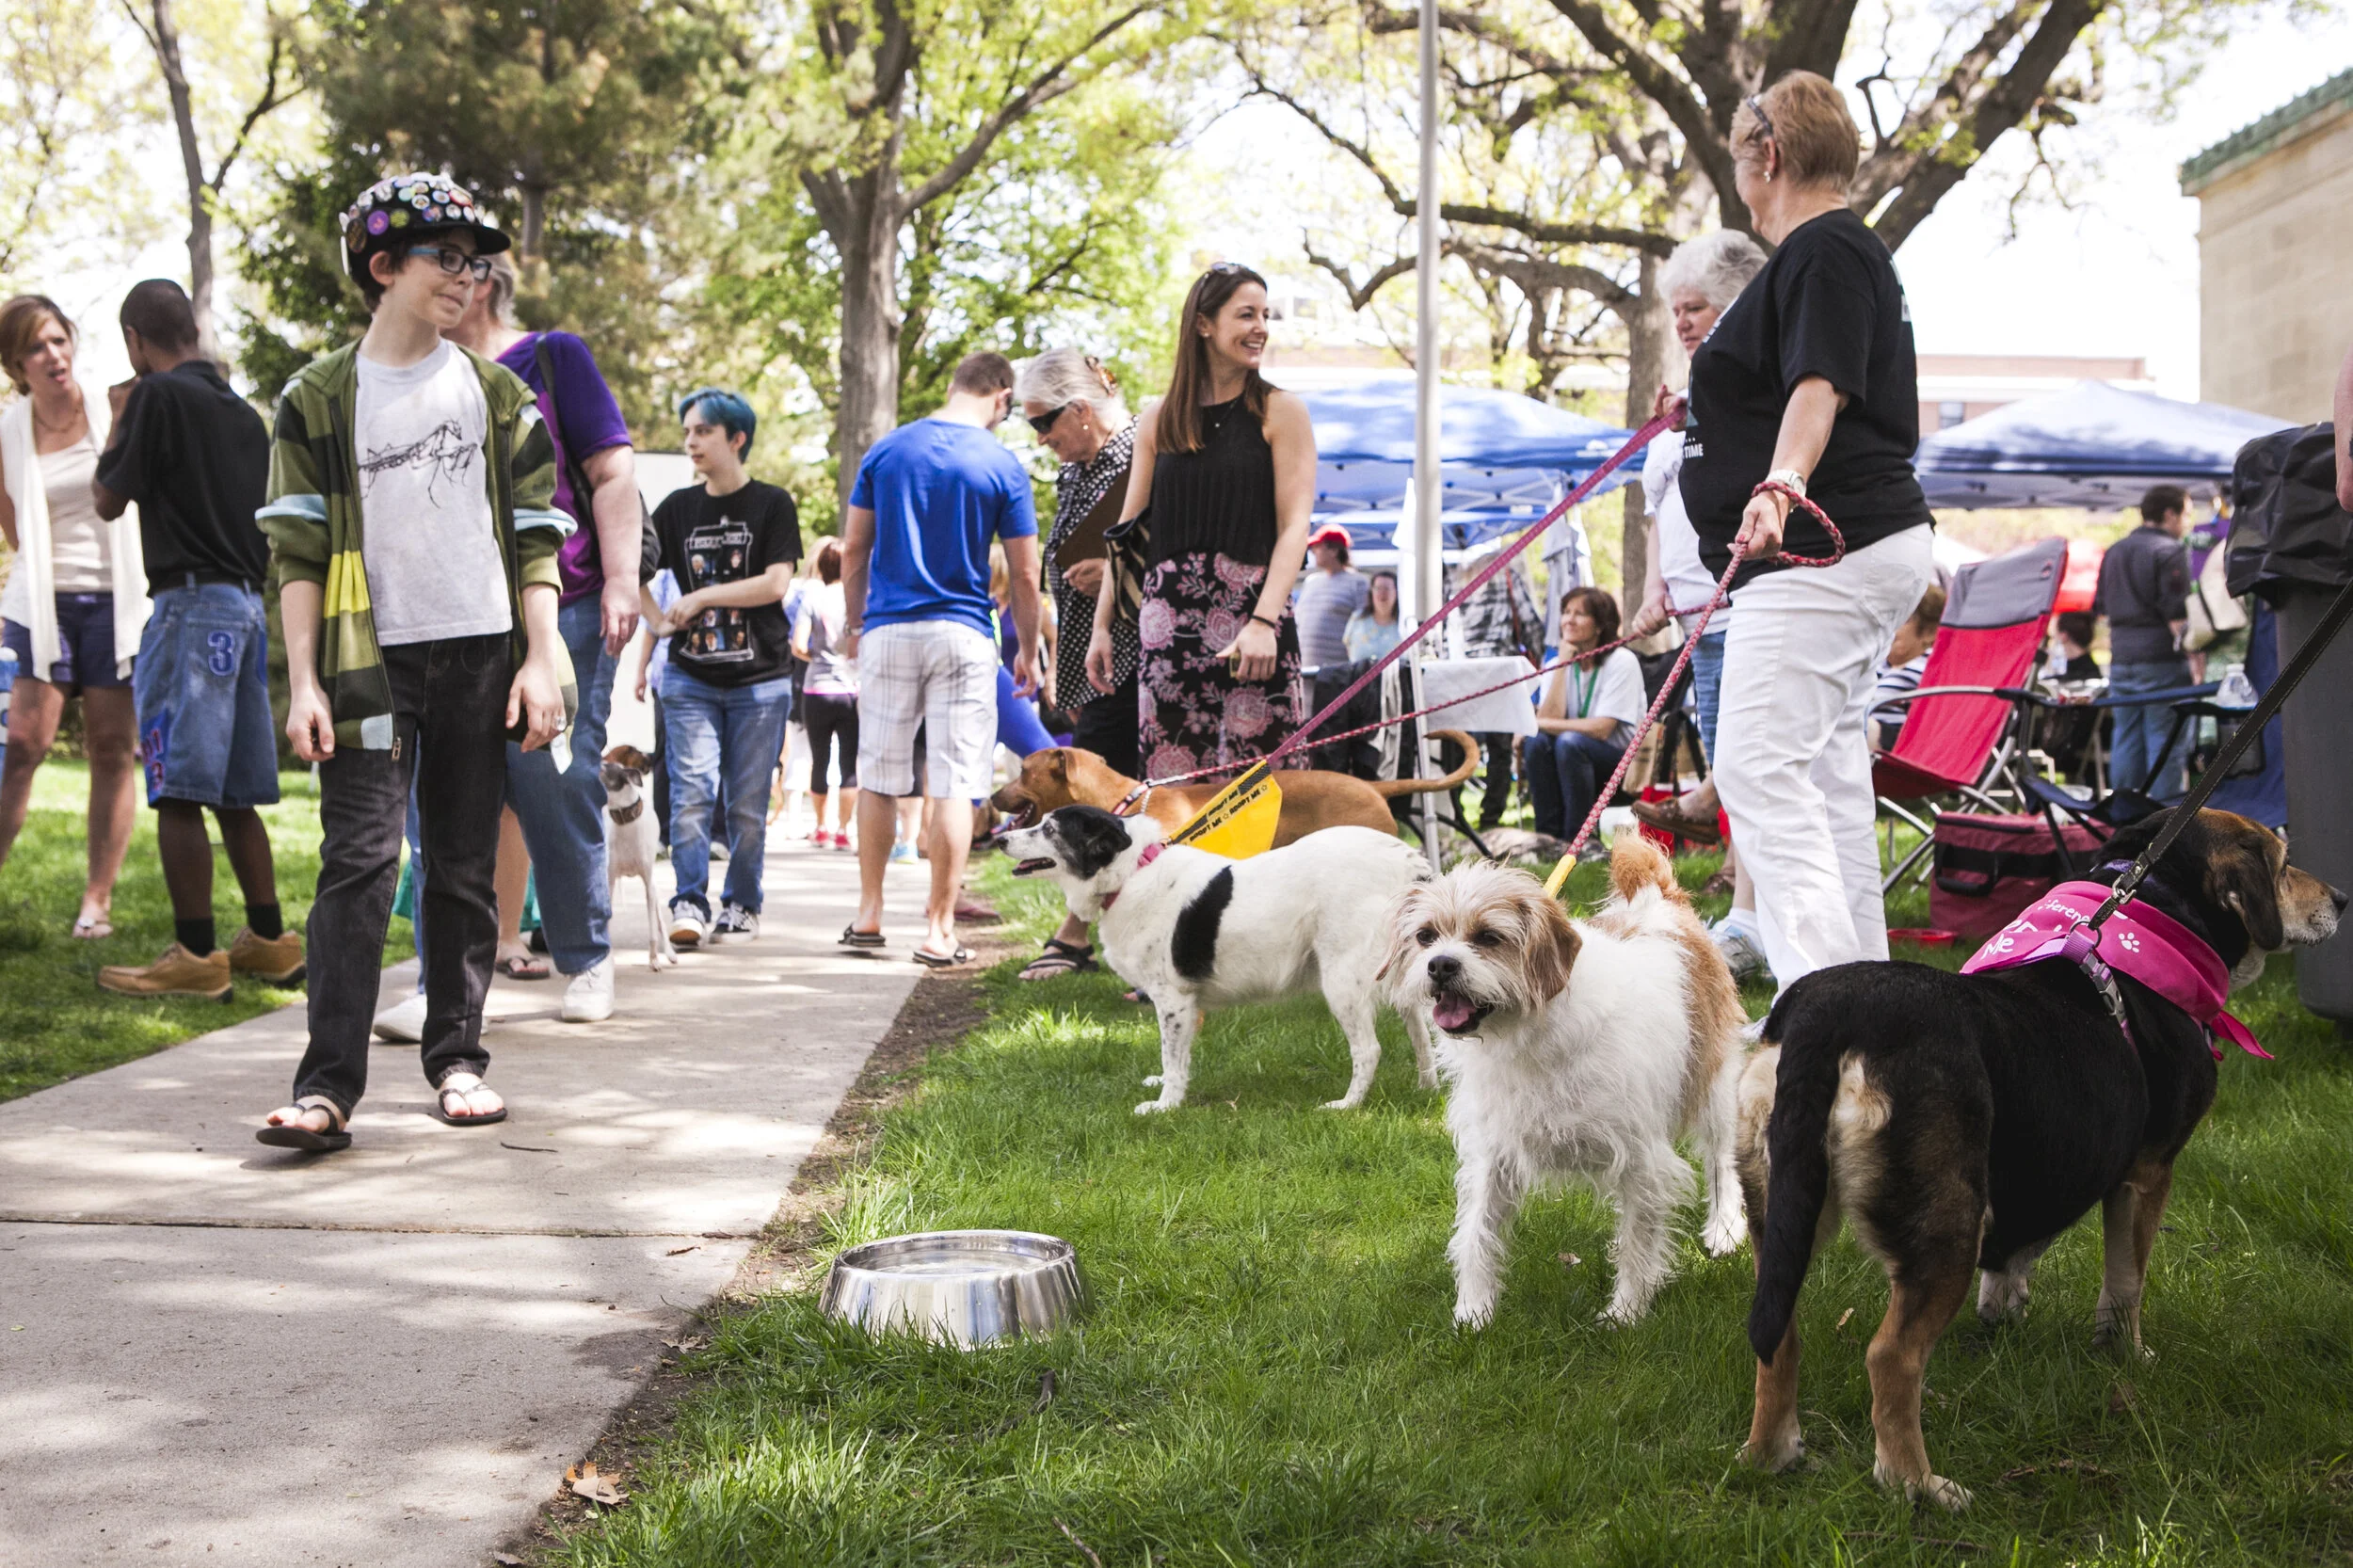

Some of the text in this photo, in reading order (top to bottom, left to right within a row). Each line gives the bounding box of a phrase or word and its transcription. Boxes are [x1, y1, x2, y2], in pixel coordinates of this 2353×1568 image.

[207, 630, 234, 676] 3
[1228, 789, 1238, 800] ME
[1190, 789, 1260, 841] ADOPT ME ADOPT ME
[1980, 933, 2014, 960] Me
